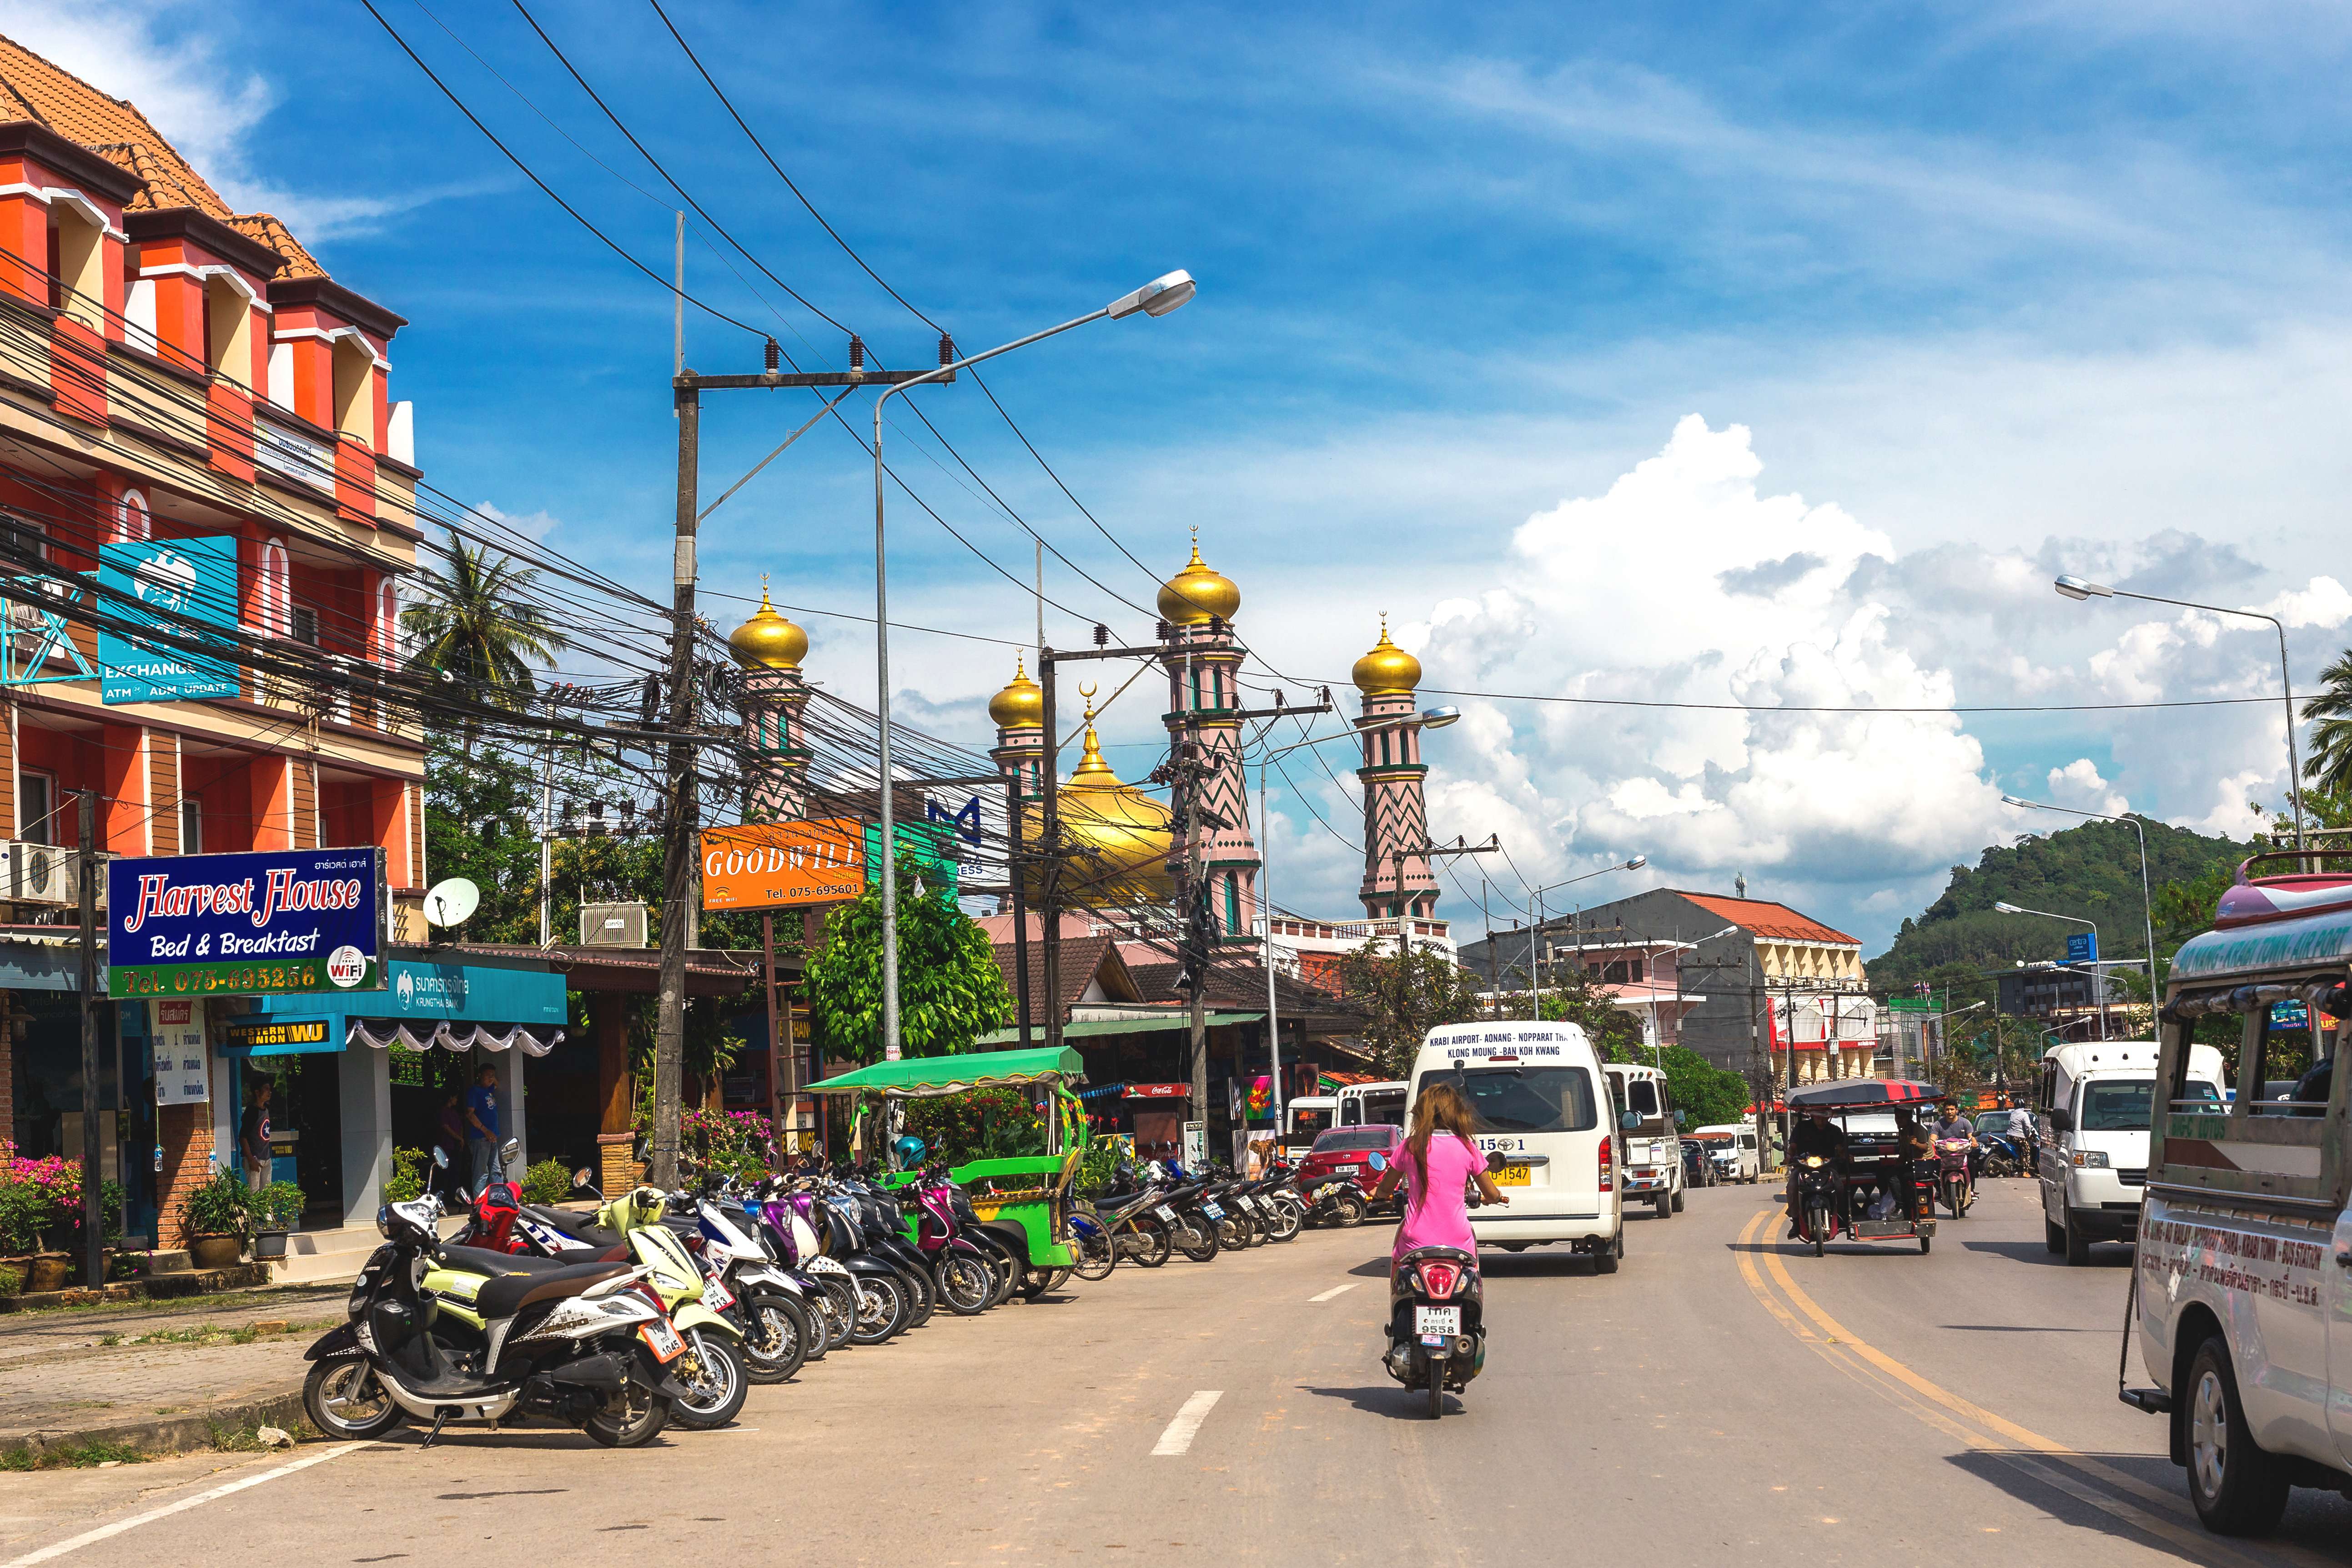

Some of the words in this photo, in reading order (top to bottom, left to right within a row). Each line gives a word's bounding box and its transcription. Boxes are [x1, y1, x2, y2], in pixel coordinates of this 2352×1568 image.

[106, 663, 197, 678] EXCHANGE
[106, 688, 132, 698] ATM
[150, 685, 177, 695] ADM
[184, 683, 227, 694] UPDATE
[315, 859, 347, 869] ฮาร์เวสต์
[349, 858, 367, 868] เฮาส์
[705, 841, 860, 877] GOODWILL
[834, 870, 856, 879] Hotel
[766, 888, 786, 900] Tel.
[790, 883, 859, 898] 075-695601
[125, 874, 254, 932] Harvest
[251, 868, 361, 927] House
[151, 934, 191, 957] Bed
[196, 934, 210, 955] &
[220, 928, 320, 955] Breakfast
[331, 964, 362, 977] WiFi
[123, 970, 166, 993] Tel.
[175, 965, 316, 992] 075-695256
[416, 975, 469, 998] ธนาคารกรุงไทย
[416, 997, 445, 1008] KRUNGTHAI
[446, 998, 459, 1008] BANK
[230, 1026, 285, 1036] WESTERN
[291, 1024, 323, 1042] WU
[248, 1035, 285, 1045] UNION
[1430, 1036, 1449, 1047] KRABI
[1484, 1033, 1512, 1043] AONANG
[1518, 1033, 1553, 1042] NOPPARAT
[1447, 1048, 1470, 1058] KLONG
[1472, 1047, 1497, 1056] MOUNG
[1519, 1046, 1533, 1055] KOH
[1536, 1046, 1560, 1055] KWANG
[710, 1296, 728, 1310] 713
[1422, 1325, 1455, 1334] 9558
[662, 1339, 680, 1356] 1045
